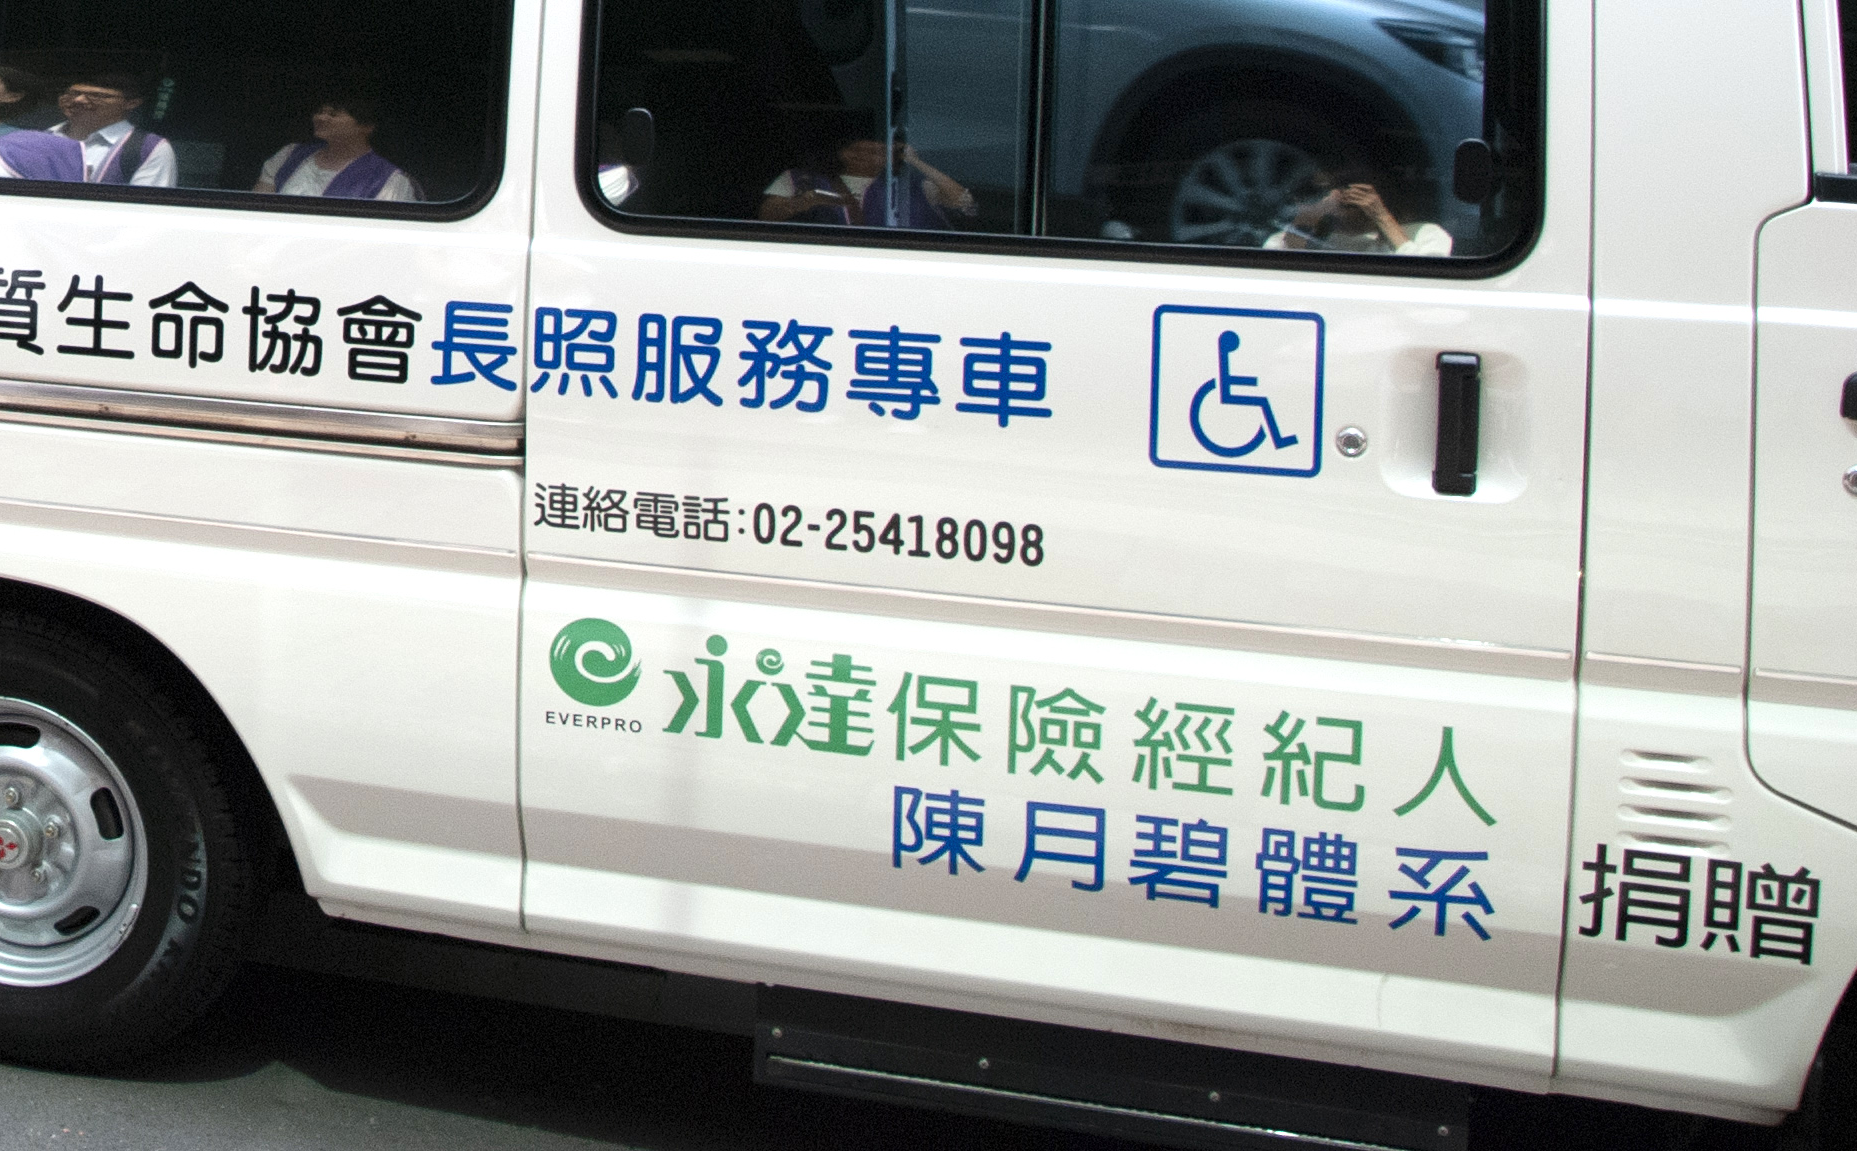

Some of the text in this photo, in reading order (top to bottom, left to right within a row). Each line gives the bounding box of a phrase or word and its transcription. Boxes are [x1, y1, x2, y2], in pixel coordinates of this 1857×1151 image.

[545, 710, 643, 734] EVERPRO
[891, 785, 1496, 943] 陳月碧體系
[1578, 842, 1823, 966] 捐贈
